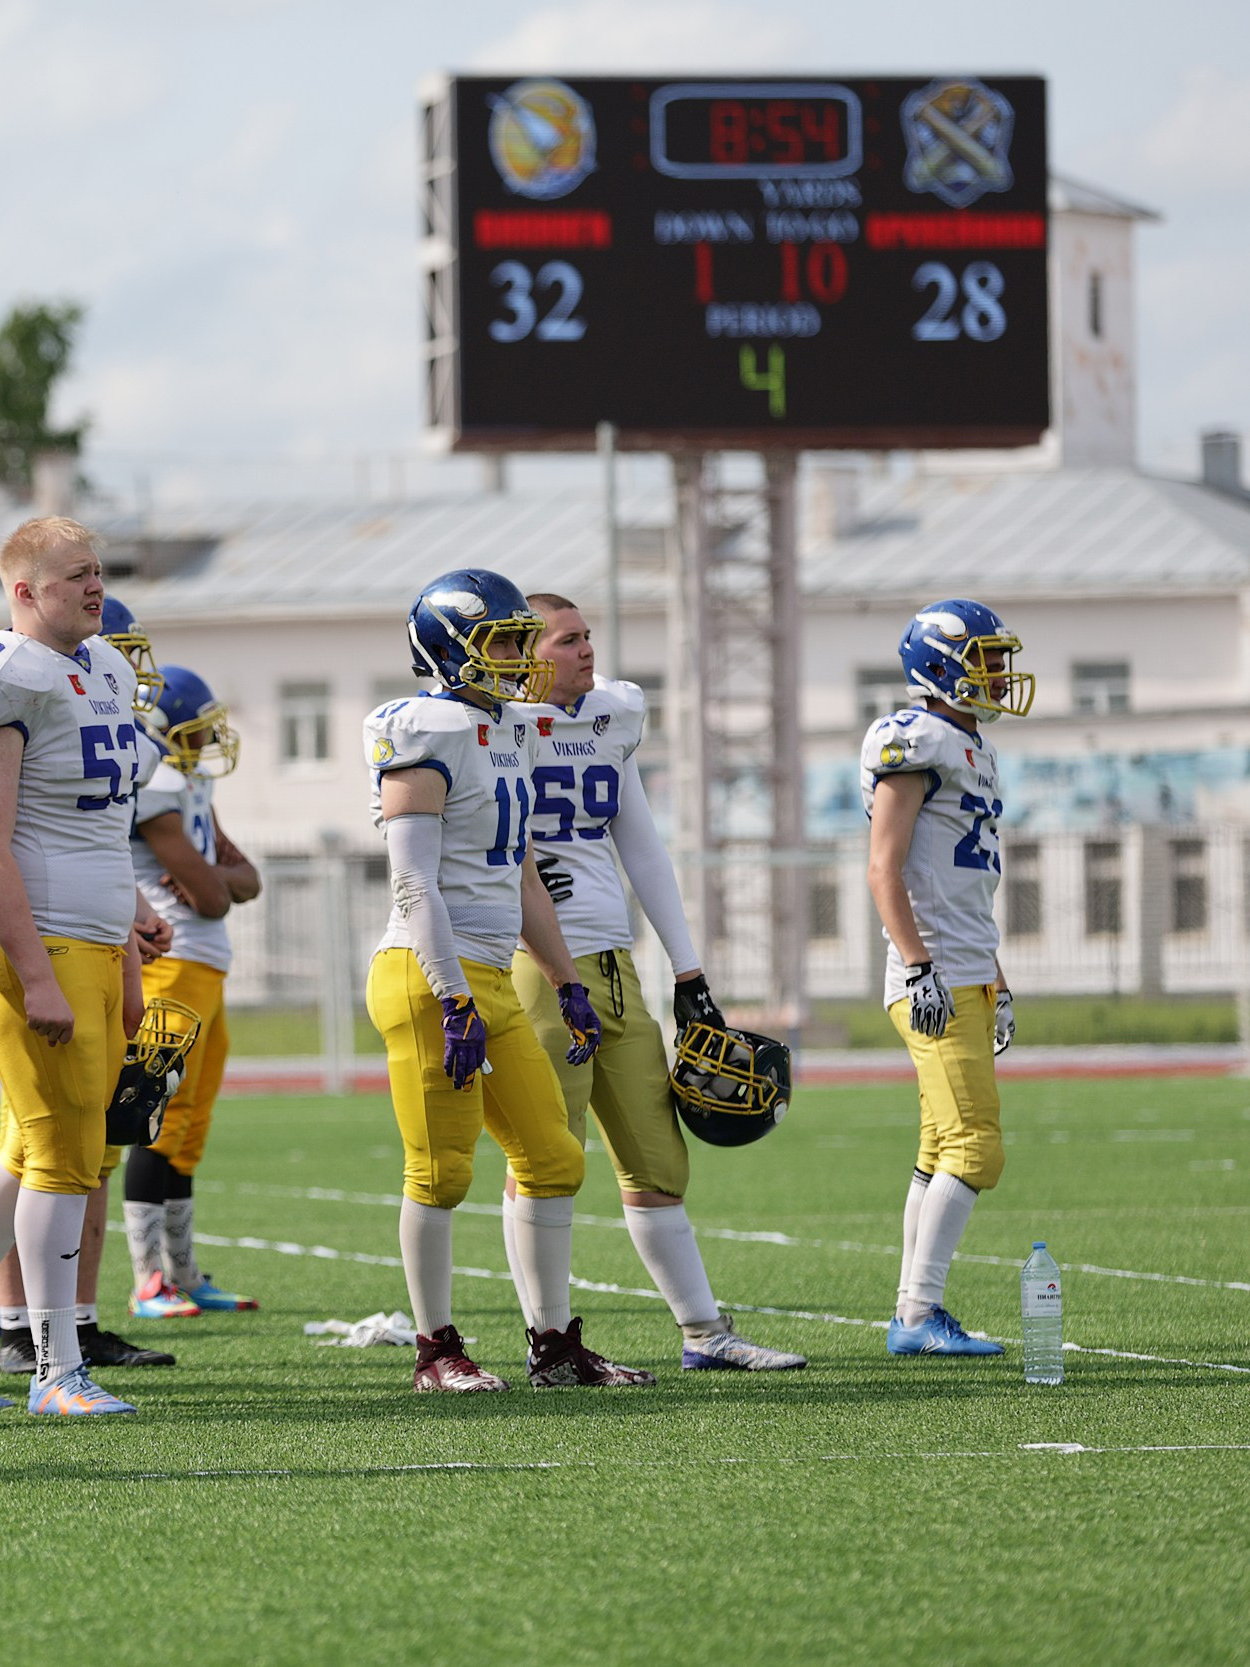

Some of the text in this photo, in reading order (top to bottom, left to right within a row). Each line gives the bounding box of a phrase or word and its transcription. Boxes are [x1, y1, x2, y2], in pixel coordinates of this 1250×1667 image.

[709, 100, 840, 166] 8:54
[654, 210, 755, 245] DOWN
[488, 259, 587, 343] 32
[694, 241, 715, 304] 1
[780, 241, 849, 304] 10
[911, 260, 1007, 342] 28
[705, 301, 822, 338] PERIOD
[739, 343, 786, 418] 4
[489, 751, 520, 769] VIKINGS
[552, 739, 597, 757] VIKINGS
[486, 777, 530, 866] 11
[528, 764, 619, 842] 59
